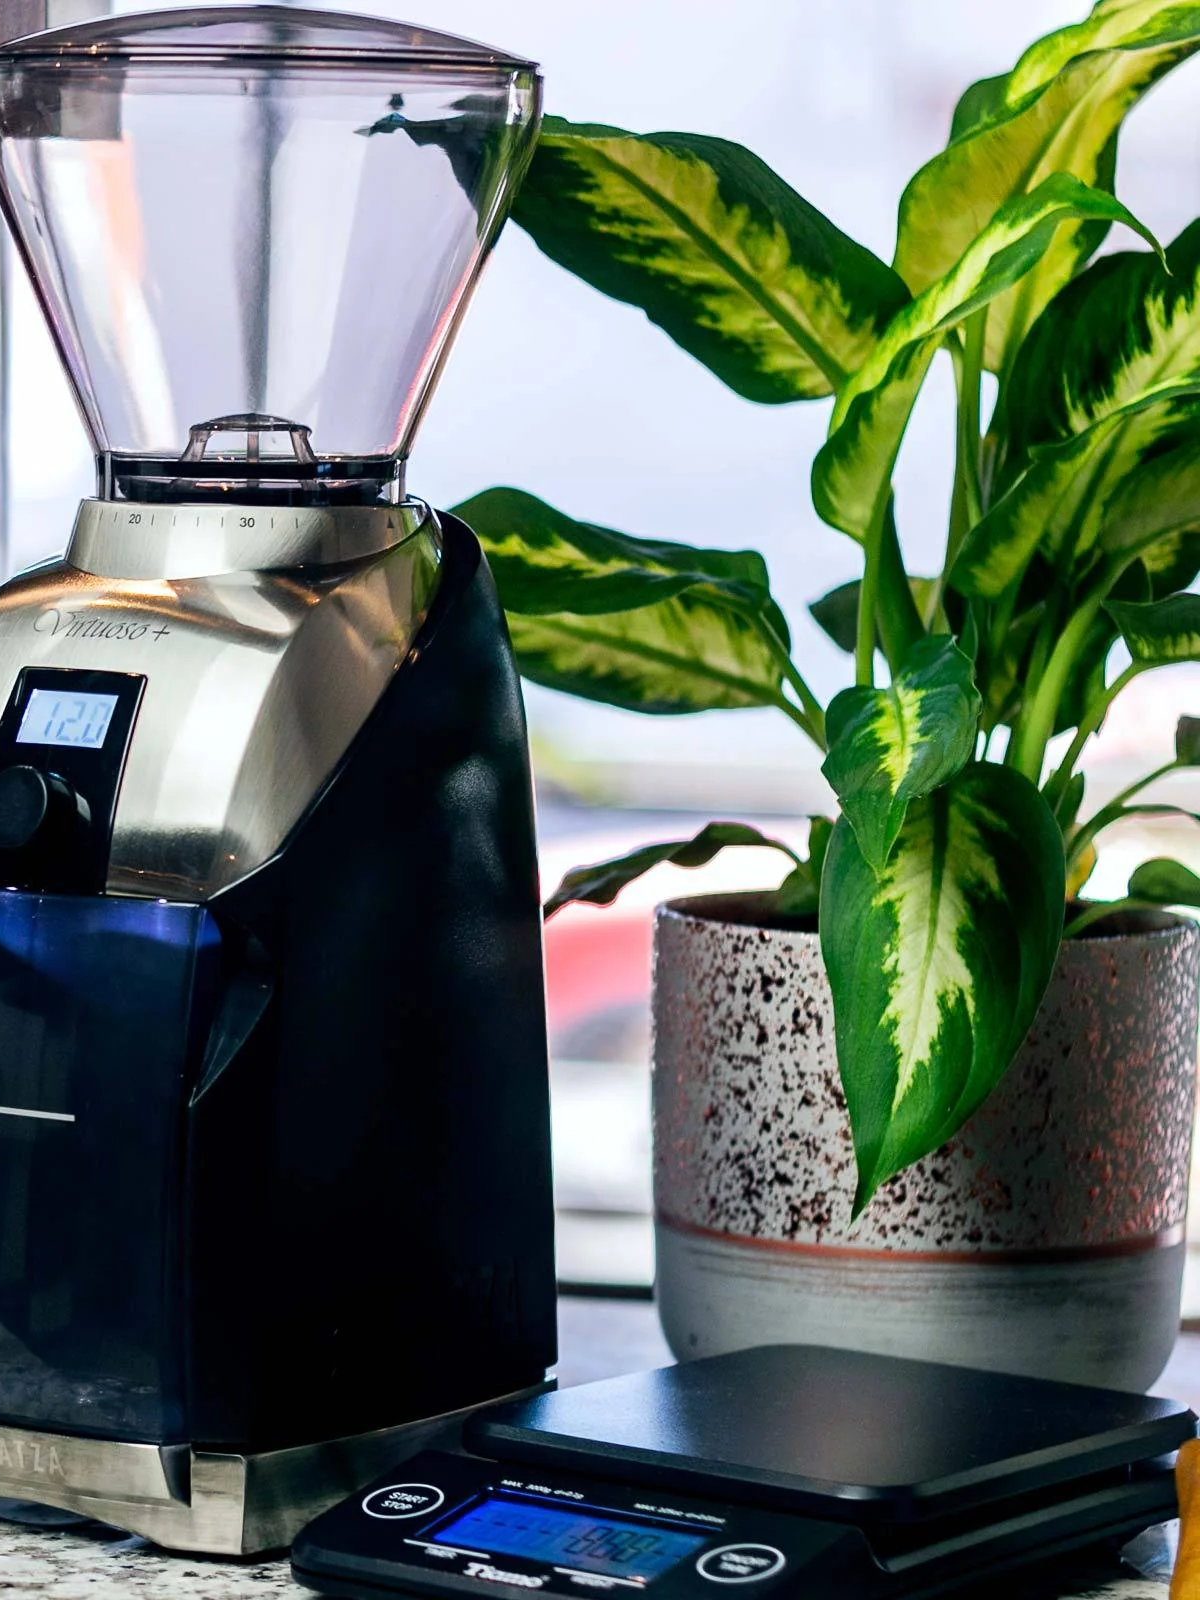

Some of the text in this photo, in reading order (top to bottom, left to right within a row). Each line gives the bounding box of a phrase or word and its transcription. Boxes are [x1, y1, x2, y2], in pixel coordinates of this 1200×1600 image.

[128, 513, 256, 529] 20 30
[388, 1491, 429, 1504] START
[381, 1500, 413, 1510] STOP
